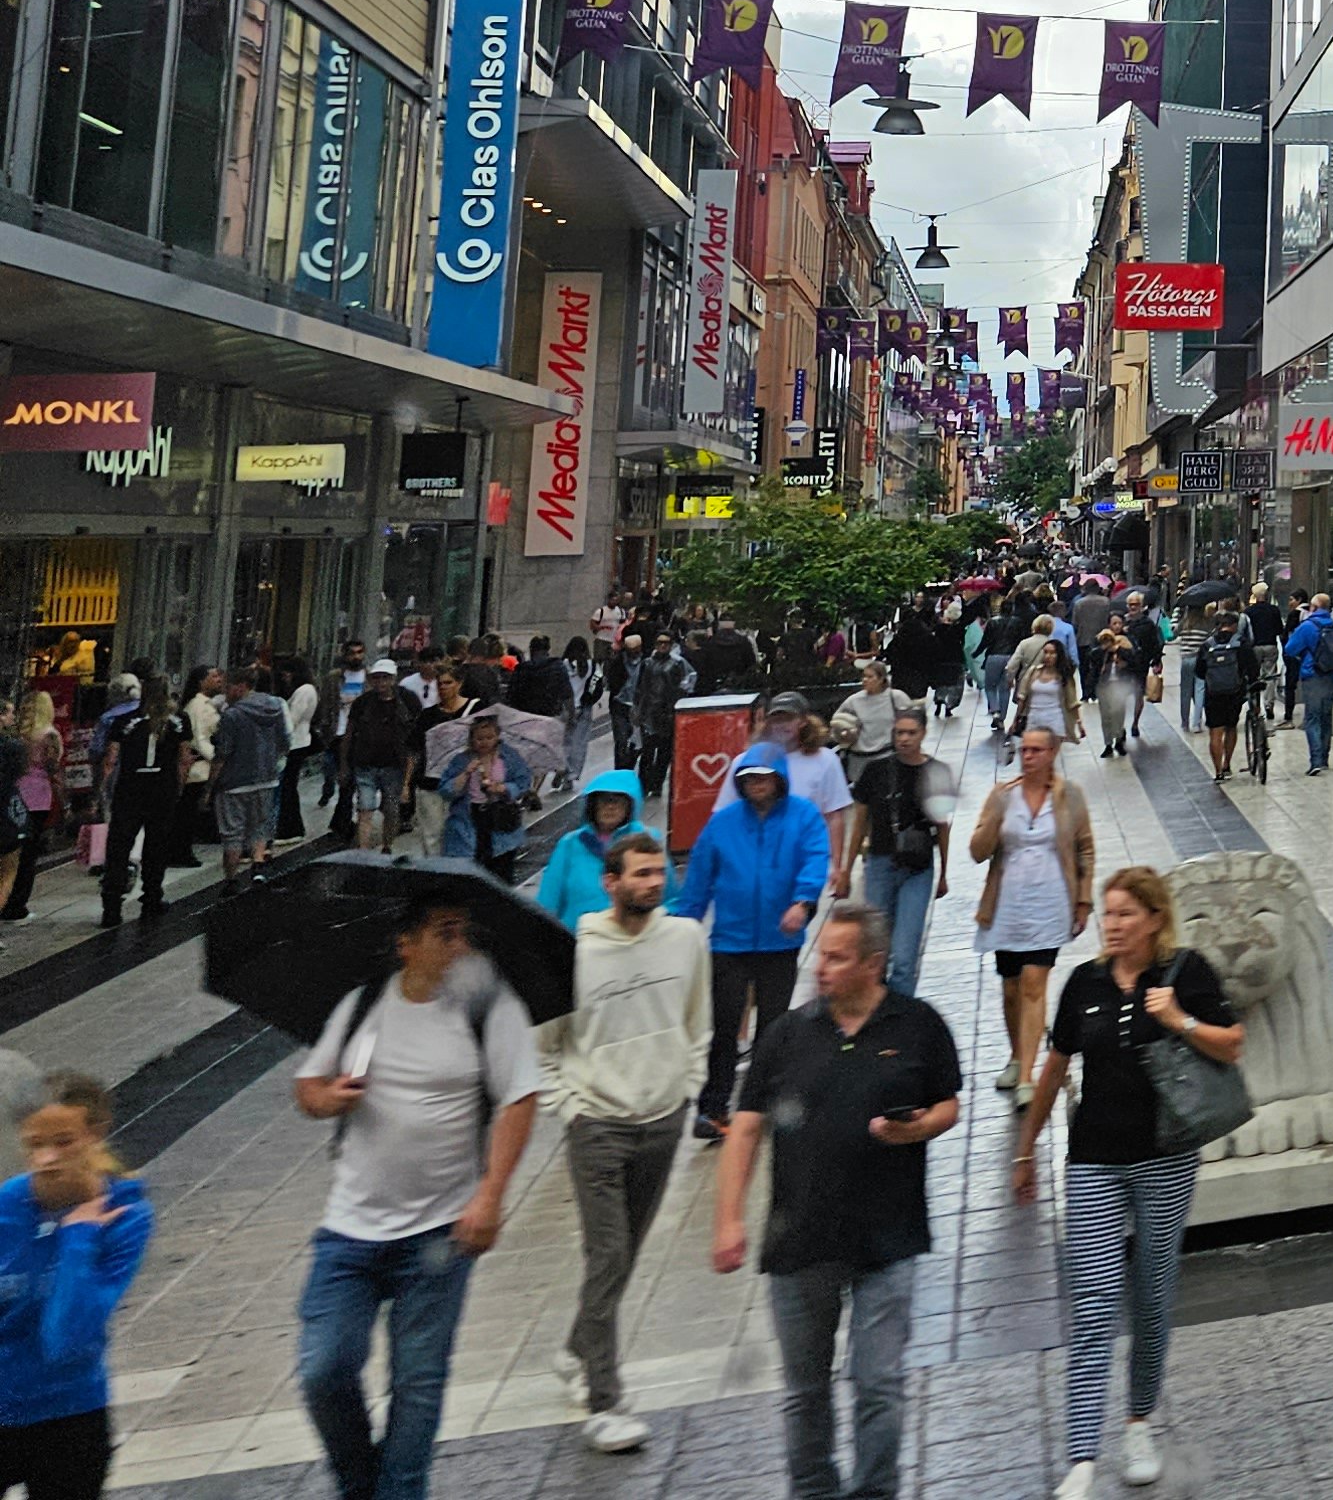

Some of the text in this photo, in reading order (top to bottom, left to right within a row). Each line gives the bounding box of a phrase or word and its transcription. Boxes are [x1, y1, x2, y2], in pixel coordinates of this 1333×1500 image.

[566, 8, 624, 22] DROTTNING
[575, 18, 606, 28] GATAN
[852, 54, 884, 65] GATAN
[1105, 63, 1159, 76] DROTTNING
[1116, 73, 1146, 83] GATAN
[461, 15, 509, 227] Clas Ohlson
[1123, 273, 1218, 306] Hötorgs
[1127, 306, 1211, 317] PASSAGEN
[251, 453, 323, 470] KappAhl
[1186, 456, 1217, 466] HALL
[1185, 466, 1217, 475] BERG
[1184, 477, 1217, 488] GULD
